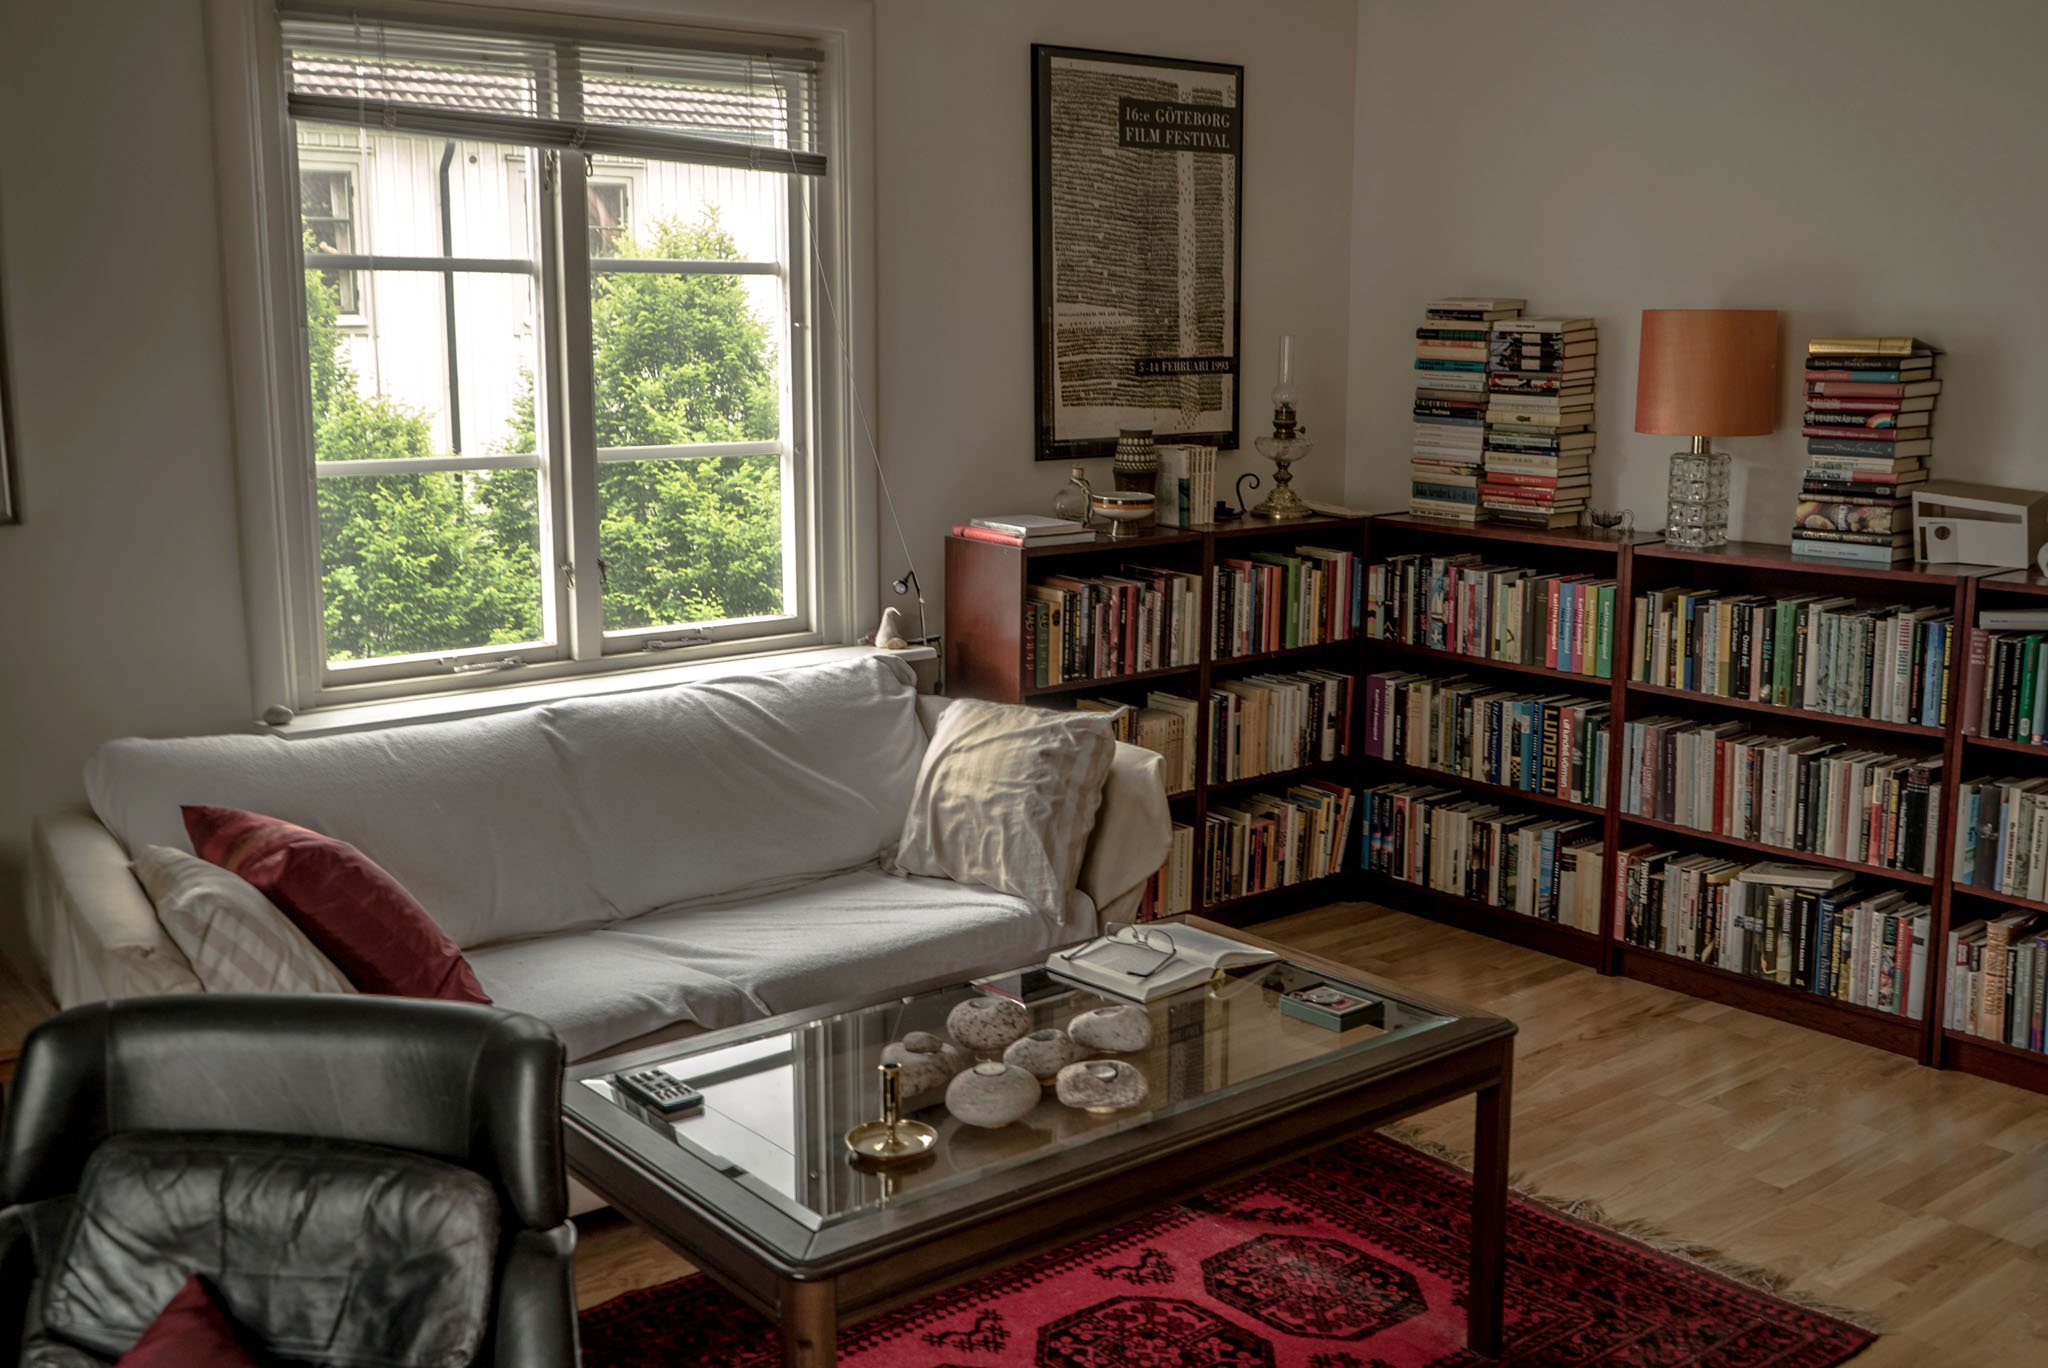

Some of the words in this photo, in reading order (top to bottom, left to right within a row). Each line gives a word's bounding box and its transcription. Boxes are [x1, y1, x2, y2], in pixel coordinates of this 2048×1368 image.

[1125, 106, 1150, 122] 16:e
[1155, 106, 1231, 128] GÖTEBORG
[1125, 127, 1160, 143] FILM
[1165, 129, 1230, 148] FESTIVAL
[1161, 360, 1208, 372] FEBRUARI
[1210, 360, 1230, 370] 1993
[1898, 618, 1911, 648] PHILIP
[1897, 650, 1909, 675] ROTH
[1543, 709, 1557, 788] LUNDELL
[1638, 879, 1649, 905] WOLFE
[1830, 925, 1842, 974] REGISSÖREN
